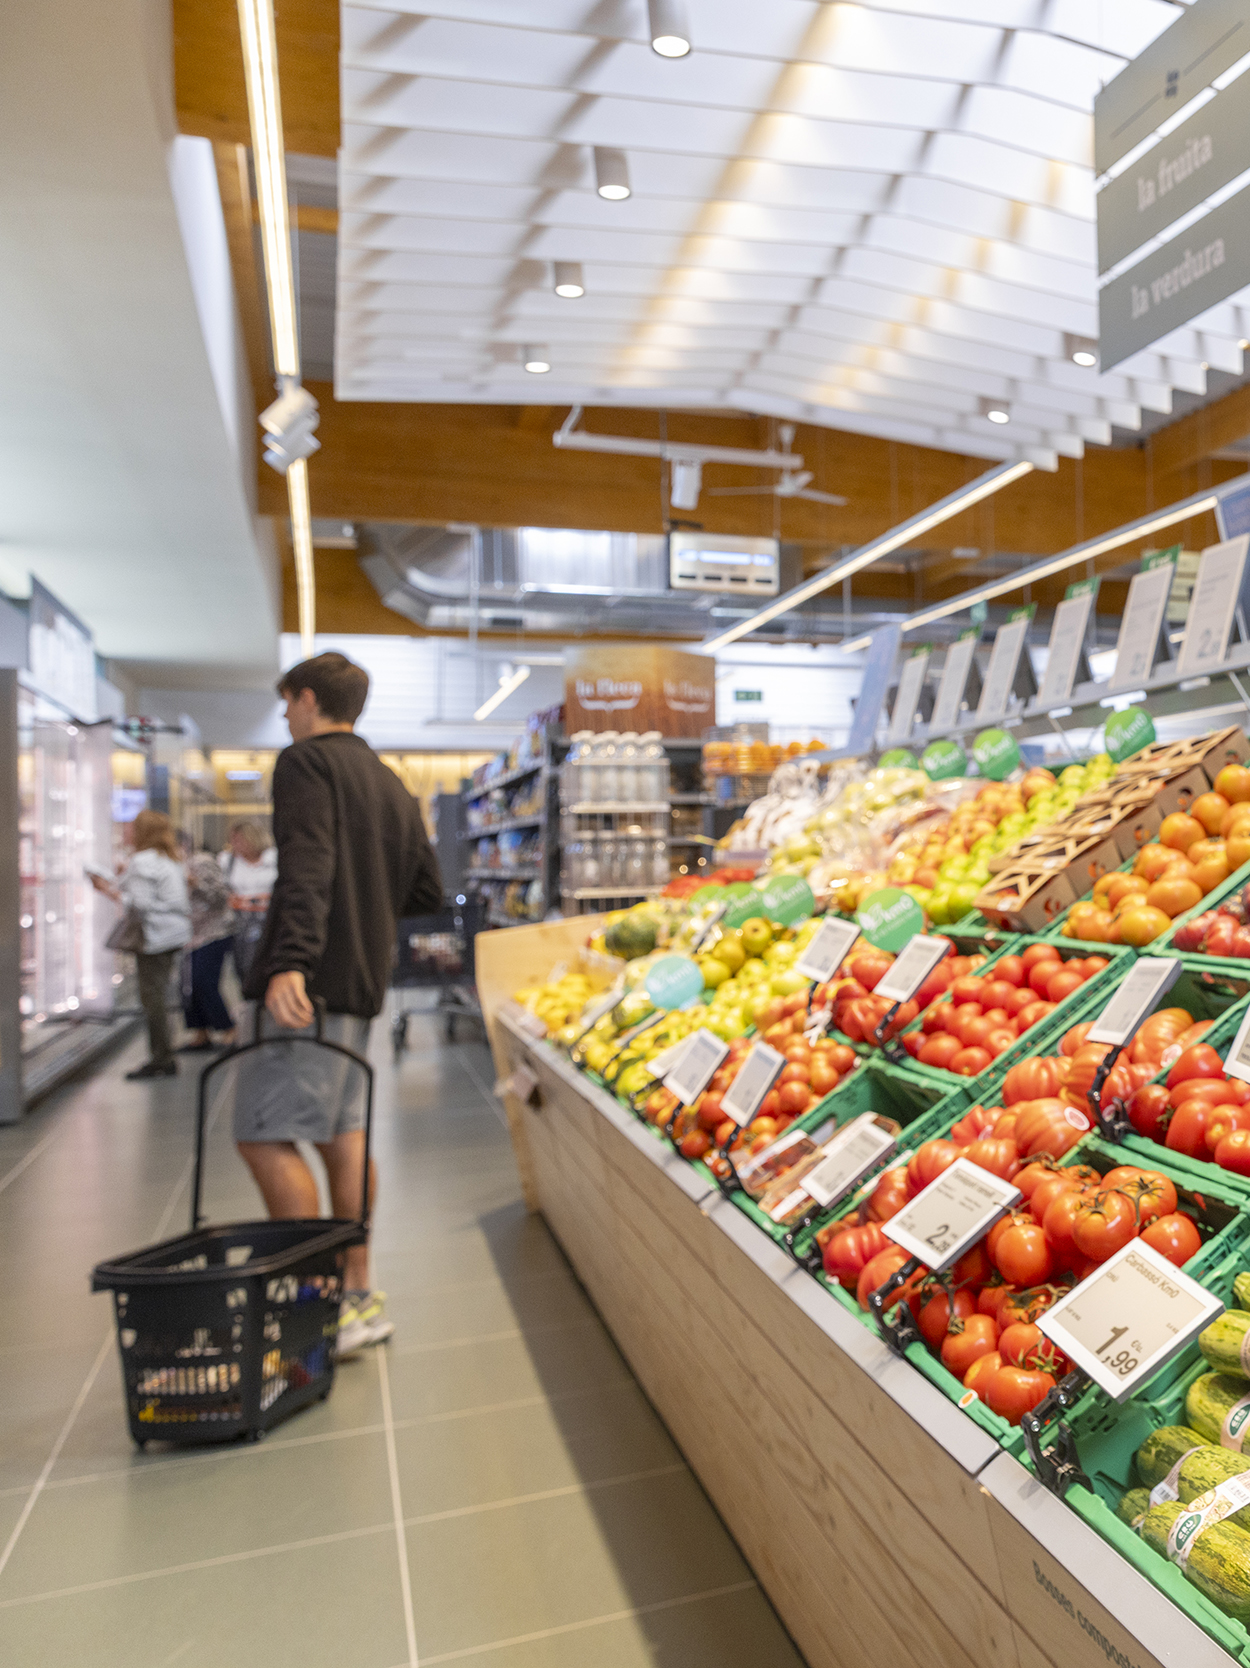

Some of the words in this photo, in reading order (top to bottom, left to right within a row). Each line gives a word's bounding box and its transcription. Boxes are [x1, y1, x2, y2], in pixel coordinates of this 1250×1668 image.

[1151, 237, 1226, 306] verdura
[1125, 1254, 1162, 1285] Carbassó
[1157, 1280, 1180, 1299] Km0
[1095, 1326, 1139, 1376] 1,99
[1178, 1520, 1194, 1540] CRU
